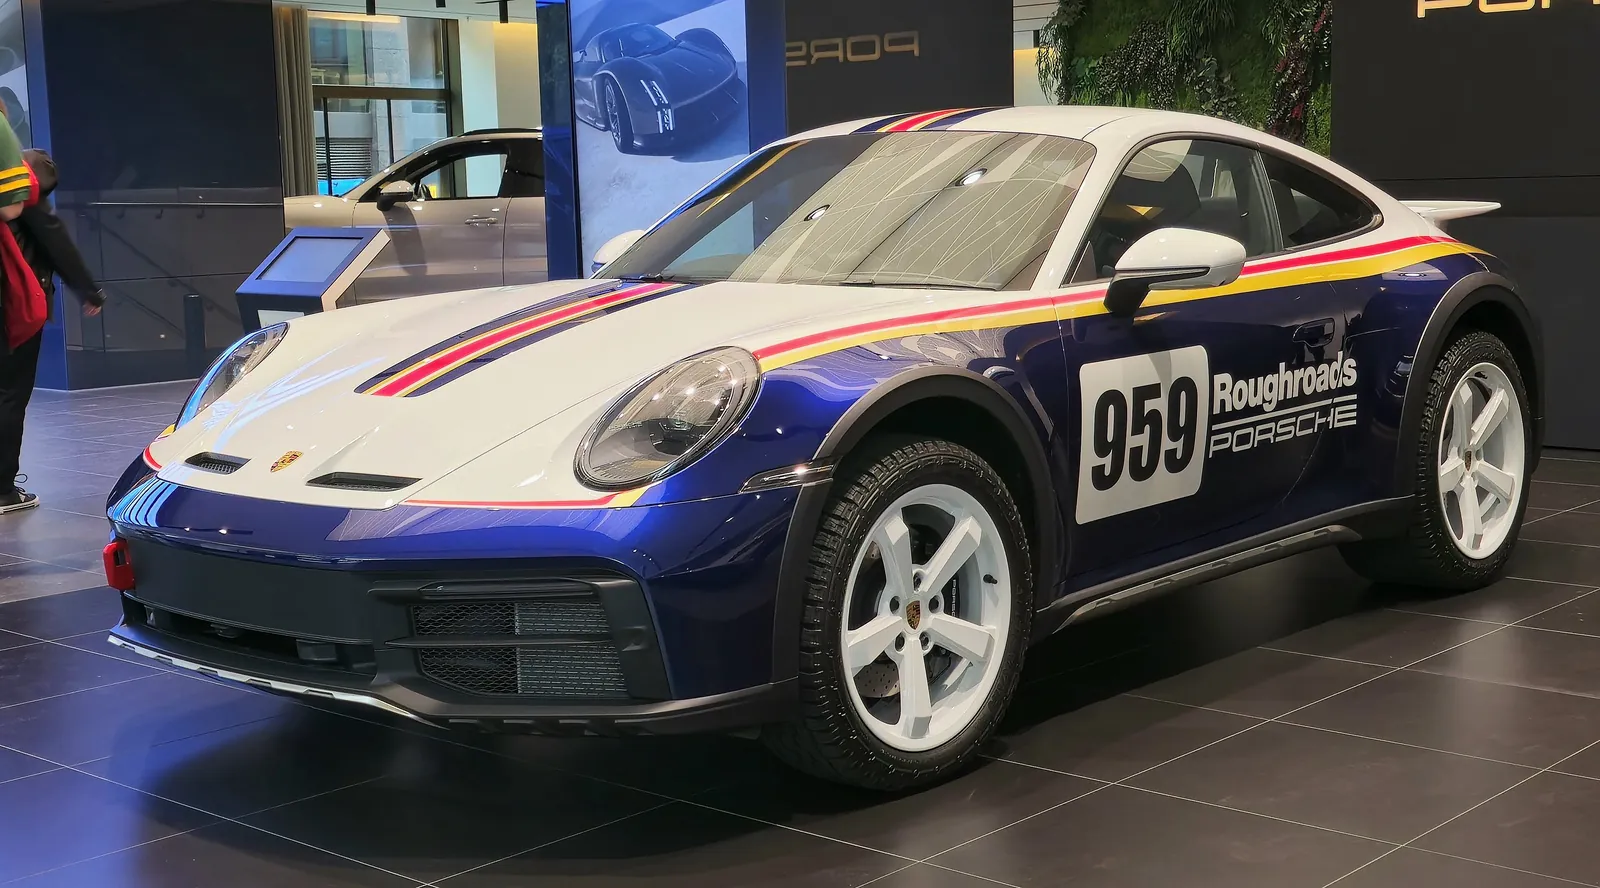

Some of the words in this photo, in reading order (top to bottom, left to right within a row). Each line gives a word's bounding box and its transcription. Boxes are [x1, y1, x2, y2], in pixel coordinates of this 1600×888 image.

[1212, 351, 1358, 416] Roughroads
[1091, 376, 1198, 492] 959
[1208, 404, 1358, 459] PORSCHE
